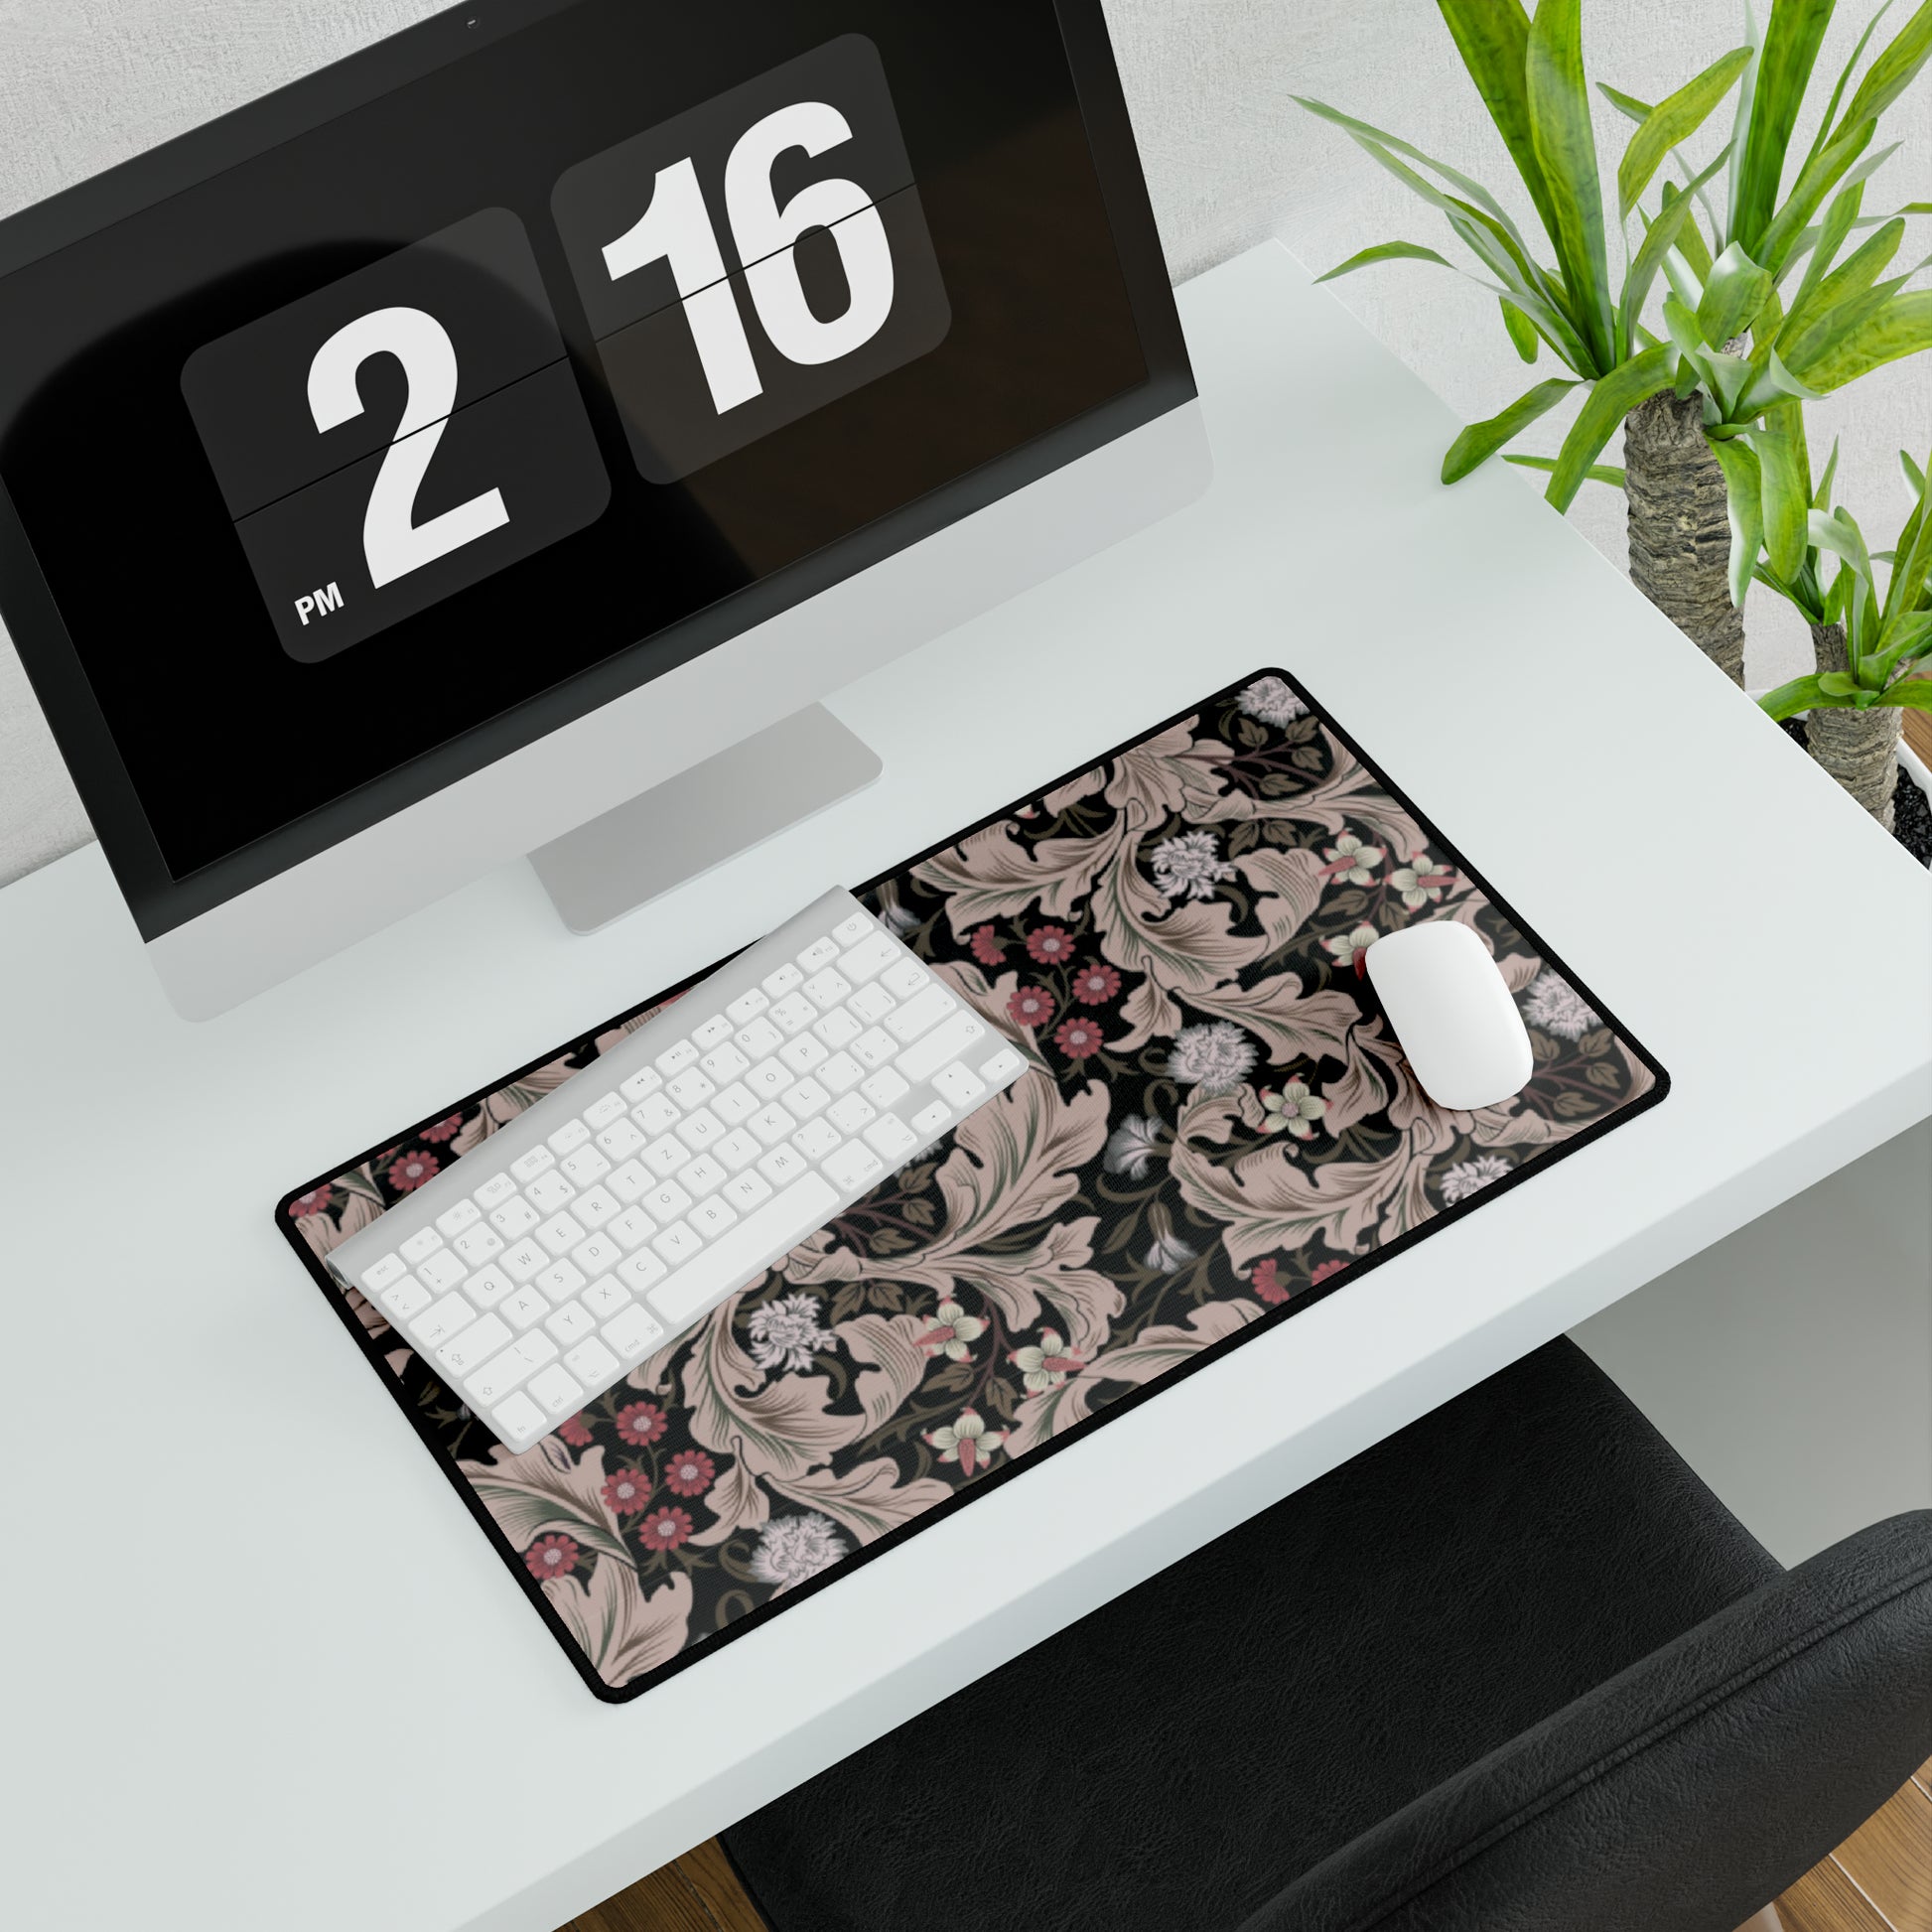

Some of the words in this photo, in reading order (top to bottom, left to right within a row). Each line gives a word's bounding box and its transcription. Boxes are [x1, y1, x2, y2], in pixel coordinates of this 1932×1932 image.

[307, 306, 510, 590] 2
[601, 100, 896, 416] 16
[295, 582, 344, 625] PM
[799, 1047, 808, 1056] P
[707, 1059, 716, 1068] 9
[672, 1084, 682, 1093] 8
[798, 1091, 810, 1101] L
[636, 1110, 645, 1119] 7
[763, 1115, 776, 1126] K
[696, 1124, 707, 1135] U
[603, 1136, 612, 1145] 6
[732, 1143, 740, 1152] J
[660, 1149, 672, 1160] Z
[567, 1162, 577, 1171] 5
[774, 1156, 789, 1168] M
[694, 1167, 706, 1178] H
[625, 1174, 636, 1184] T
[740, 1181, 753, 1194] N
[659, 1192, 671, 1204] G
[591, 1201, 602, 1211] R
[496, 1213, 506, 1222] 3
[706, 1209, 717, 1219] B
[624, 1219, 634, 1230] F
[555, 1227, 566, 1238] E
[460, 1240, 470, 1249] 2
[670, 1234, 681, 1246] V
[588, 1246, 601, 1257] D
[517, 1252, 531, 1265] W
[635, 1261, 647, 1272] C
[553, 1273, 564, 1283] S
[483, 1281, 494, 1291] Q
[599, 1288, 612, 1300] X
[518, 1300, 529, 1311] A
[563, 1313, 573, 1325] Y
